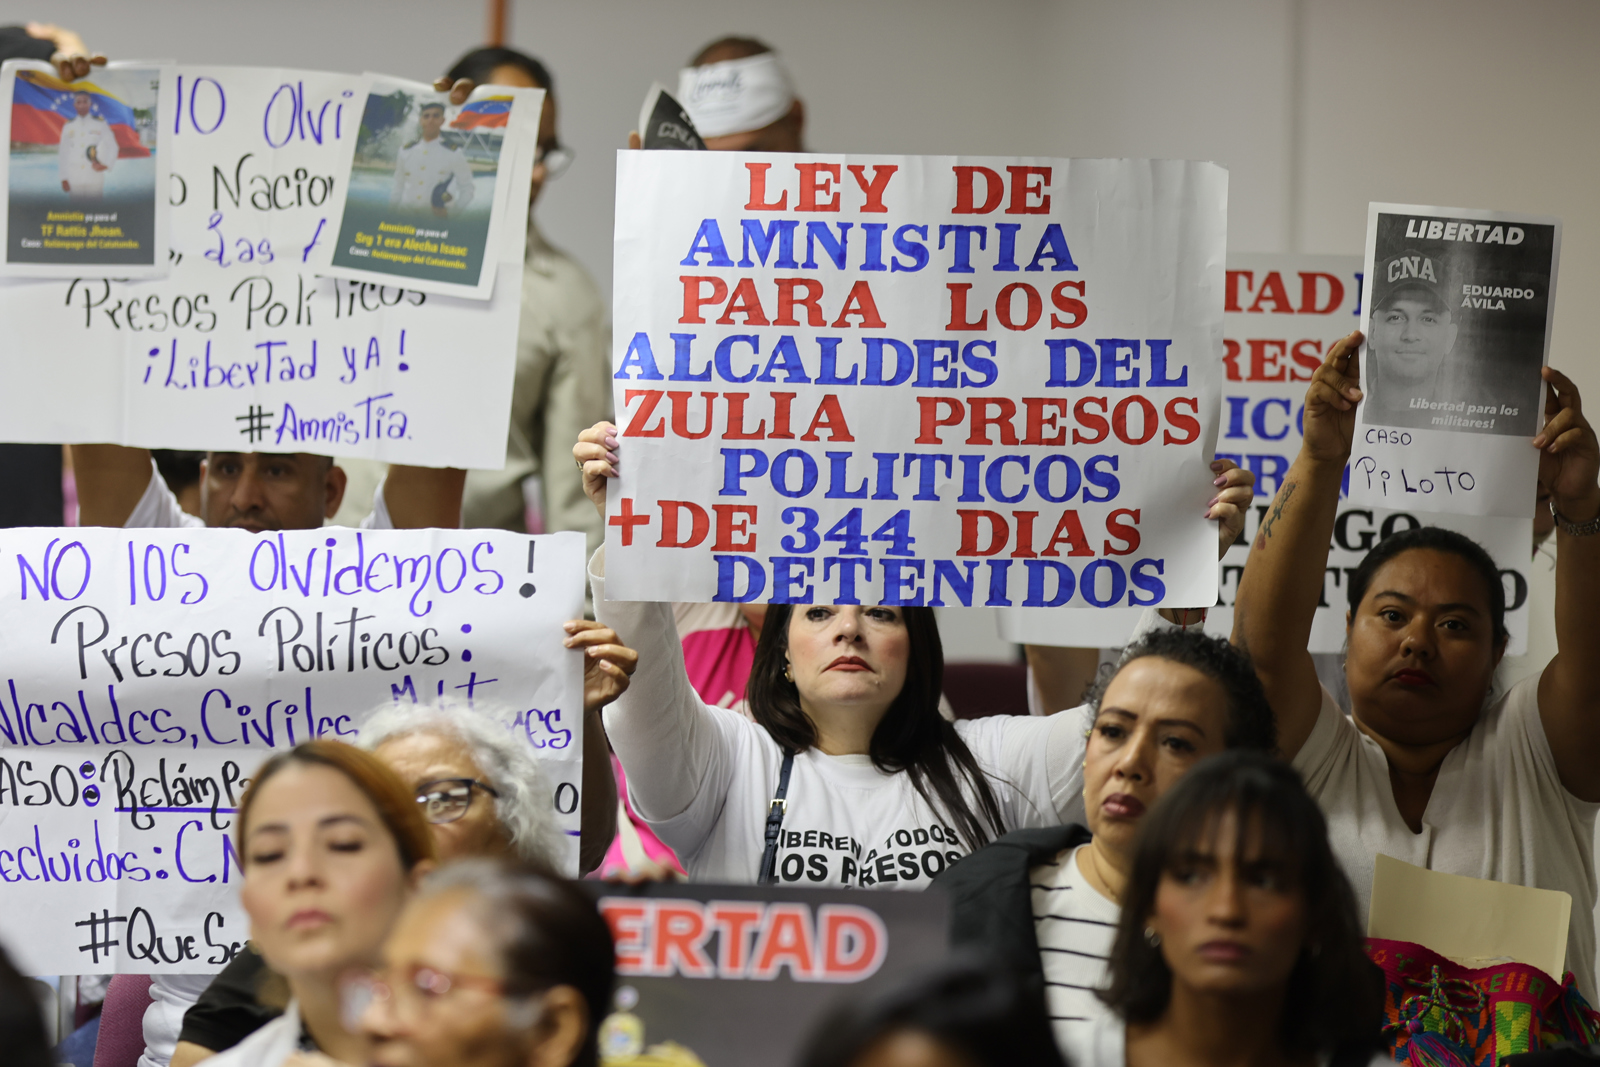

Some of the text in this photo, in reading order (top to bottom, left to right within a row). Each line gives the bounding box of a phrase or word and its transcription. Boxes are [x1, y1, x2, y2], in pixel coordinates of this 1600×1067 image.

[264, 80, 353, 149] Olvi
[213, 153, 334, 211] Nacio
[744, 162, 1052, 215] LEY DE
[440, 242, 468, 257] Isaac
[680, 218, 1079, 274] AMNISTIA
[1405, 219, 1525, 246] LIBERTAD
[1225, 270, 1345, 315] TAD
[1387, 256, 1437, 284] CNA
[1462, 284, 1535, 300] EDUARDO
[678, 275, 1088, 331] PARA LOS
[1461, 294, 1506, 311] ÁVILA
[614, 332, 1188, 388] ALCALDES DEL
[622, 389, 855, 442] ZULIA
[914, 395, 1200, 446] PRESOS
[1409, 398, 1519, 416] Libertad para los
[1431, 415, 1495, 429] militares!
[1365, 429, 1412, 446] CASO
[719, 448, 1120, 503] POLITICOS
[781, 506, 915, 556] 344
[956, 508, 1141, 558] DIAS
[16, 537, 91, 601] NO
[712, 555, 1166, 607] DETENIDOS
[100, 750, 253, 830] Relámp
[0, 819, 169, 882] ecluidos:
[775, 824, 960, 864] IBEREN A TODOS
[75, 907, 252, 965] #QueSe
[597, 897, 888, 983] ERTAD
